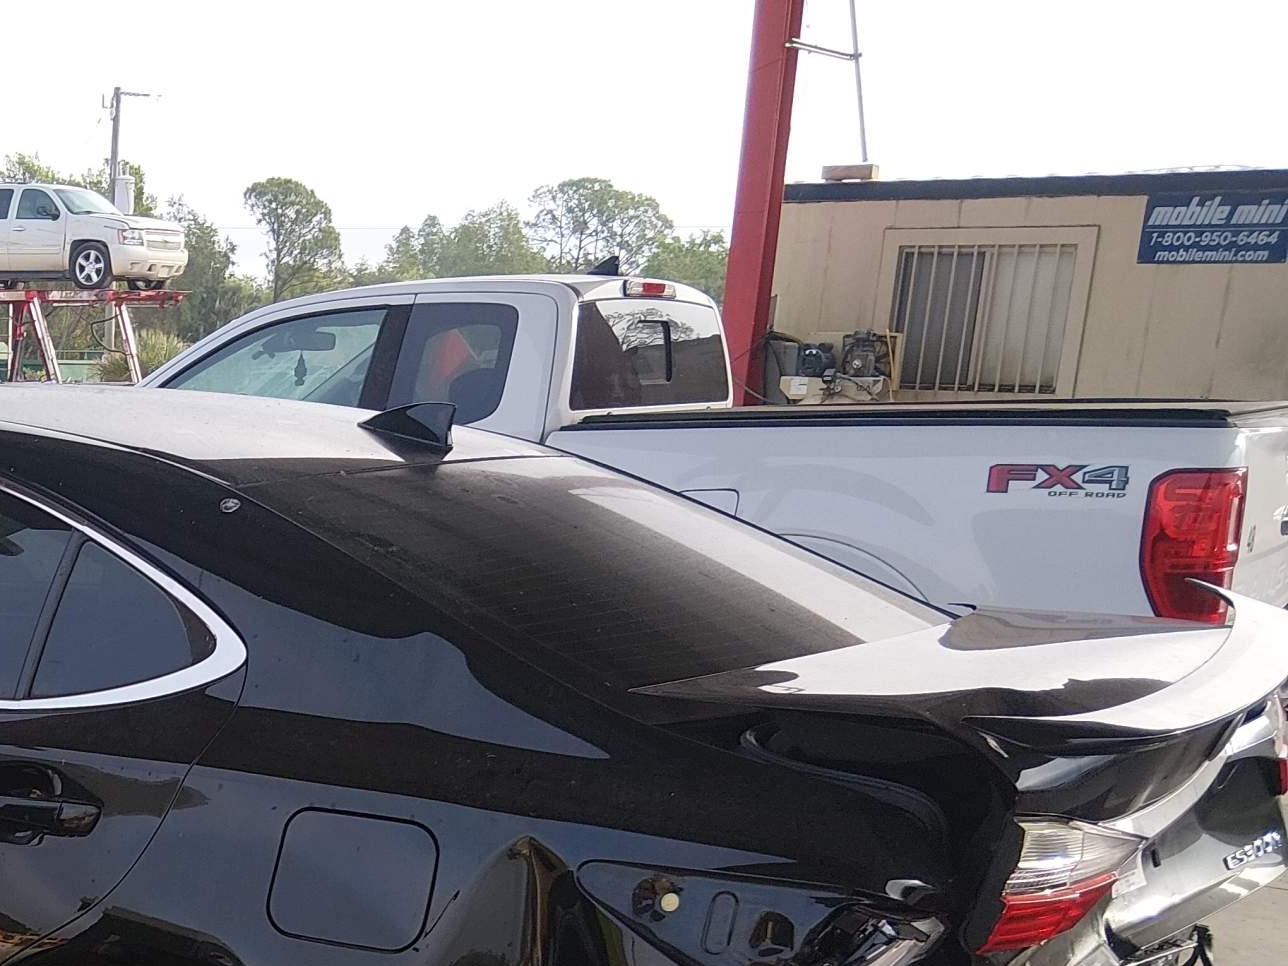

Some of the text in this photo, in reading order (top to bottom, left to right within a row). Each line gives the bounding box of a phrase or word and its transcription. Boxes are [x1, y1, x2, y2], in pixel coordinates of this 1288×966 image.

[1146, 196, 1288, 226] mobile mini
[1150, 231, 1281, 246] 1-800-950-6464
[1154, 248, 1269, 262] mobilemini.com
[986, 464, 1130, 493] FX4
